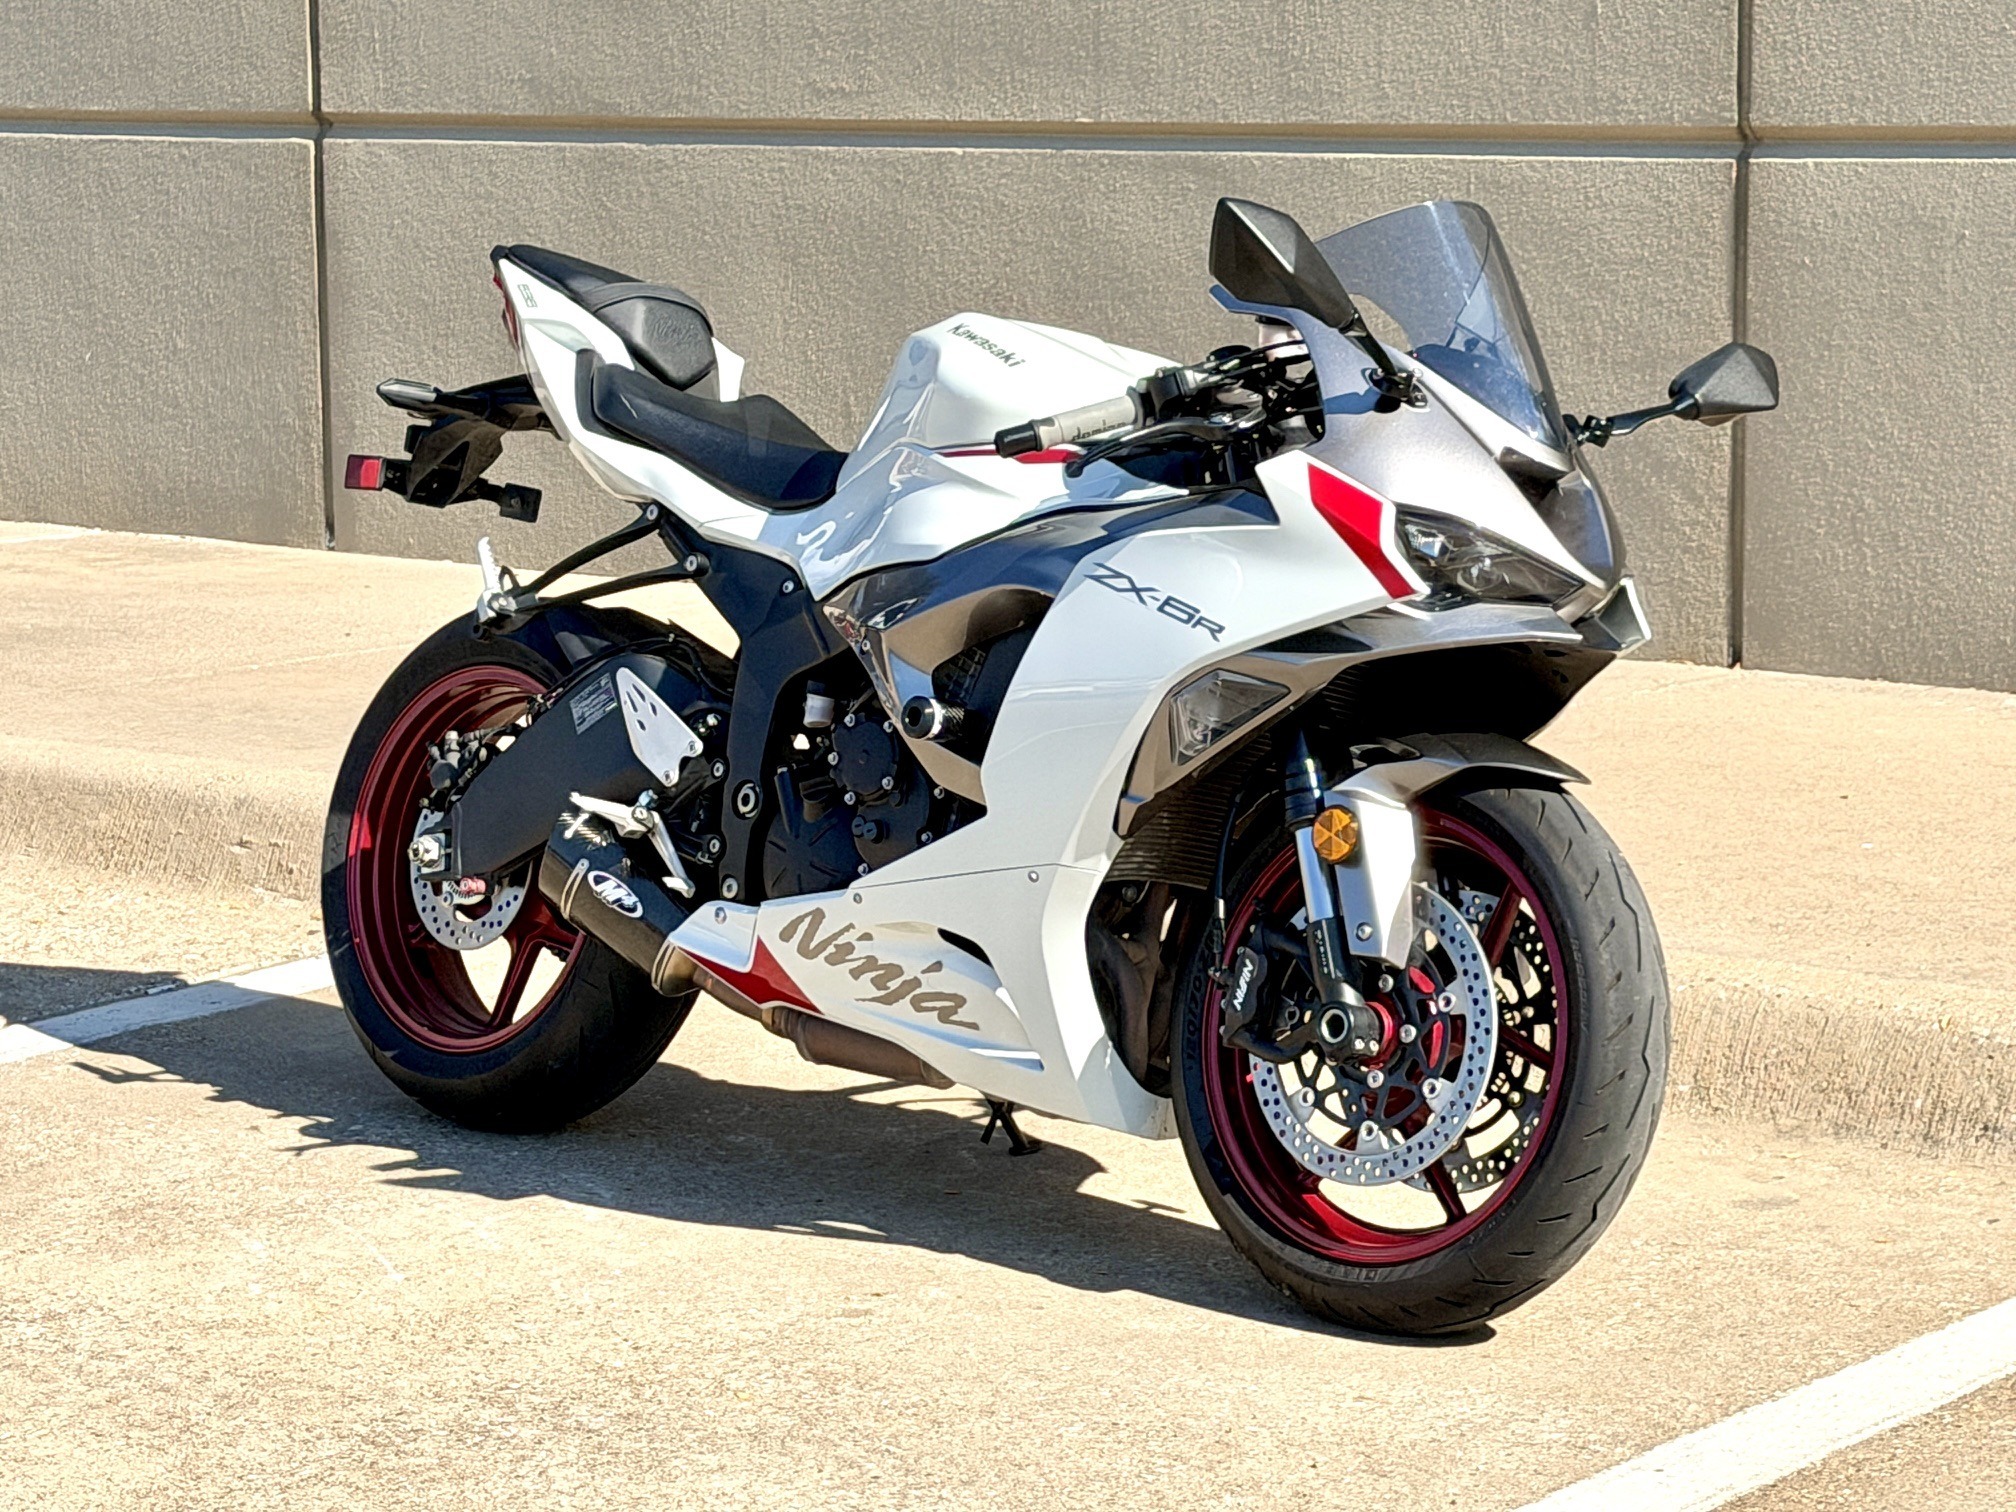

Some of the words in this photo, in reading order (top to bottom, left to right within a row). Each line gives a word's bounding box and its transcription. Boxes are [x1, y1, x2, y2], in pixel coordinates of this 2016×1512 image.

[946, 322, 1026, 367] Kawasaki
[1083, 561, 1226, 643] ZX-6R
[778, 907, 980, 1031] Ninja
